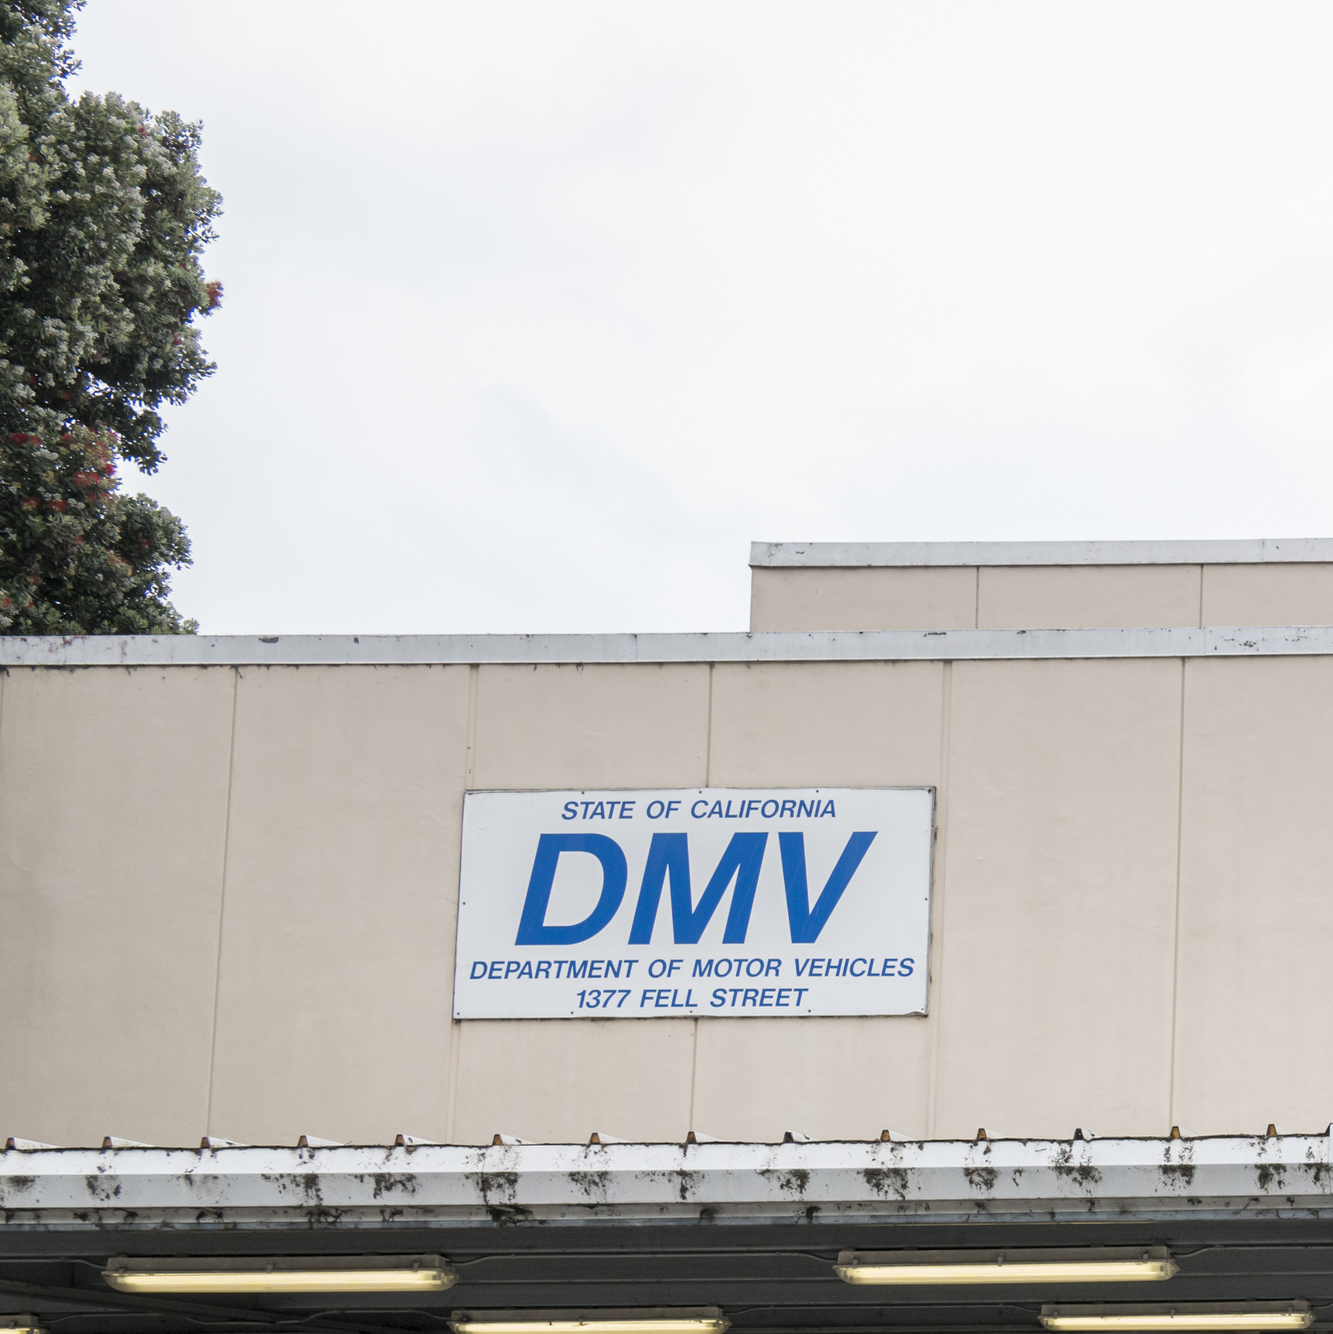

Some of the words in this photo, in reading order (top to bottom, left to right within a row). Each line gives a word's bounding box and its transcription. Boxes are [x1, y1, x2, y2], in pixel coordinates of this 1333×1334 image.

[561, 800, 636, 820] STATE
[647, 800, 682, 819] OF
[690, 799, 836, 819] CALIFORNIA
[514, 831, 879, 946] DMV
[469, 959, 639, 980] DEPARTMENT
[648, 958, 683, 978] OF
[691, 958, 782, 978] MOTOR
[794, 957, 915, 977] VEHICLES
[576, 989, 631, 1009] 1377
[639, 988, 699, 1008] FELL
[709, 987, 808, 1007] STREET
